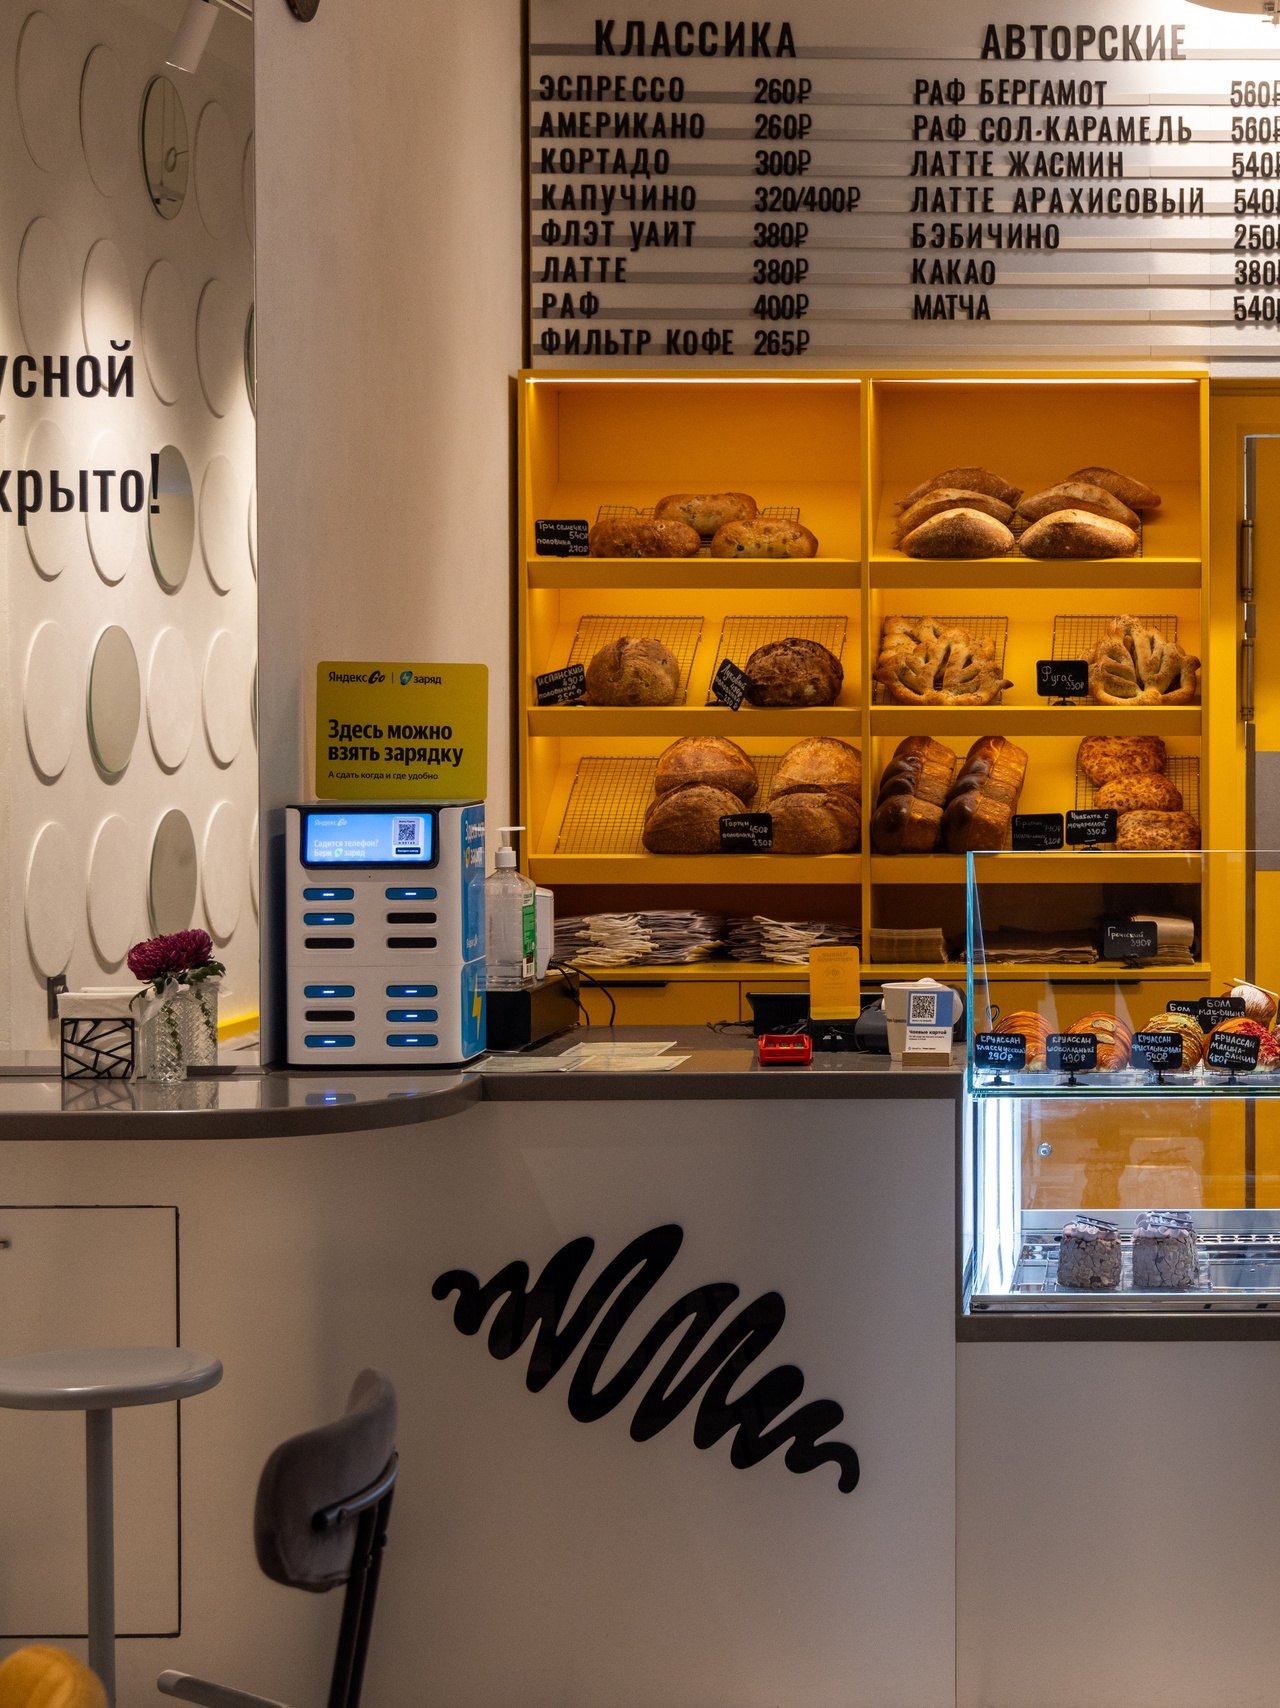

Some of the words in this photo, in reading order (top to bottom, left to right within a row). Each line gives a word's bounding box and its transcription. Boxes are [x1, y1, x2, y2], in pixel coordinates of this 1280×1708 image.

[595, 20, 796, 58] КЛАССИКА
[981, 24, 1186, 61] АВТОРСКИЕ
[539, 75, 684, 102] ЭСПРЕССО
[915, 78, 965, 106] РАФ
[980, 80, 1107, 106] БЕРГАМОТ
[539, 111, 705, 139] АМЕРИКАНО
[914, 114, 966, 142] РАФ
[541, 148, 669, 179] КОРТАДО
[910, 151, 994, 177] ЛАТТЕ
[1008, 151, 1124, 177] ЖАСМИН
[541, 184, 696, 216] КАПУЧИНО
[910, 187, 994, 213] ЛАТТЕ
[1013, 187, 1204, 214] АРАХИСОВЫЙ
[541, 219, 614, 247] ФЛЭТ
[630, 221, 696, 251] УАЙТ
[912, 223, 1059, 249] БЭБИЧИНО
[541, 257, 626, 283] ЛАТТЕ
[912, 259, 996, 285] КАКАО
[542, 291, 599, 319] РАФ
[914, 294, 990, 320] МАТЧА
[541, 328, 651, 355] ФИЛЬТР
[666, 328, 734, 355] КОФЕ
[413, 675, 442, 685] заряд
[328, 719, 383, 741] Здесь
[388, 725, 452, 740] можно
[328, 746, 380, 761] взять
[384, 748, 464, 767] зарядку
[336, 772, 359, 780] сдать
[361, 772, 384, 780] когда
[408, 772, 438, 781] удобно
